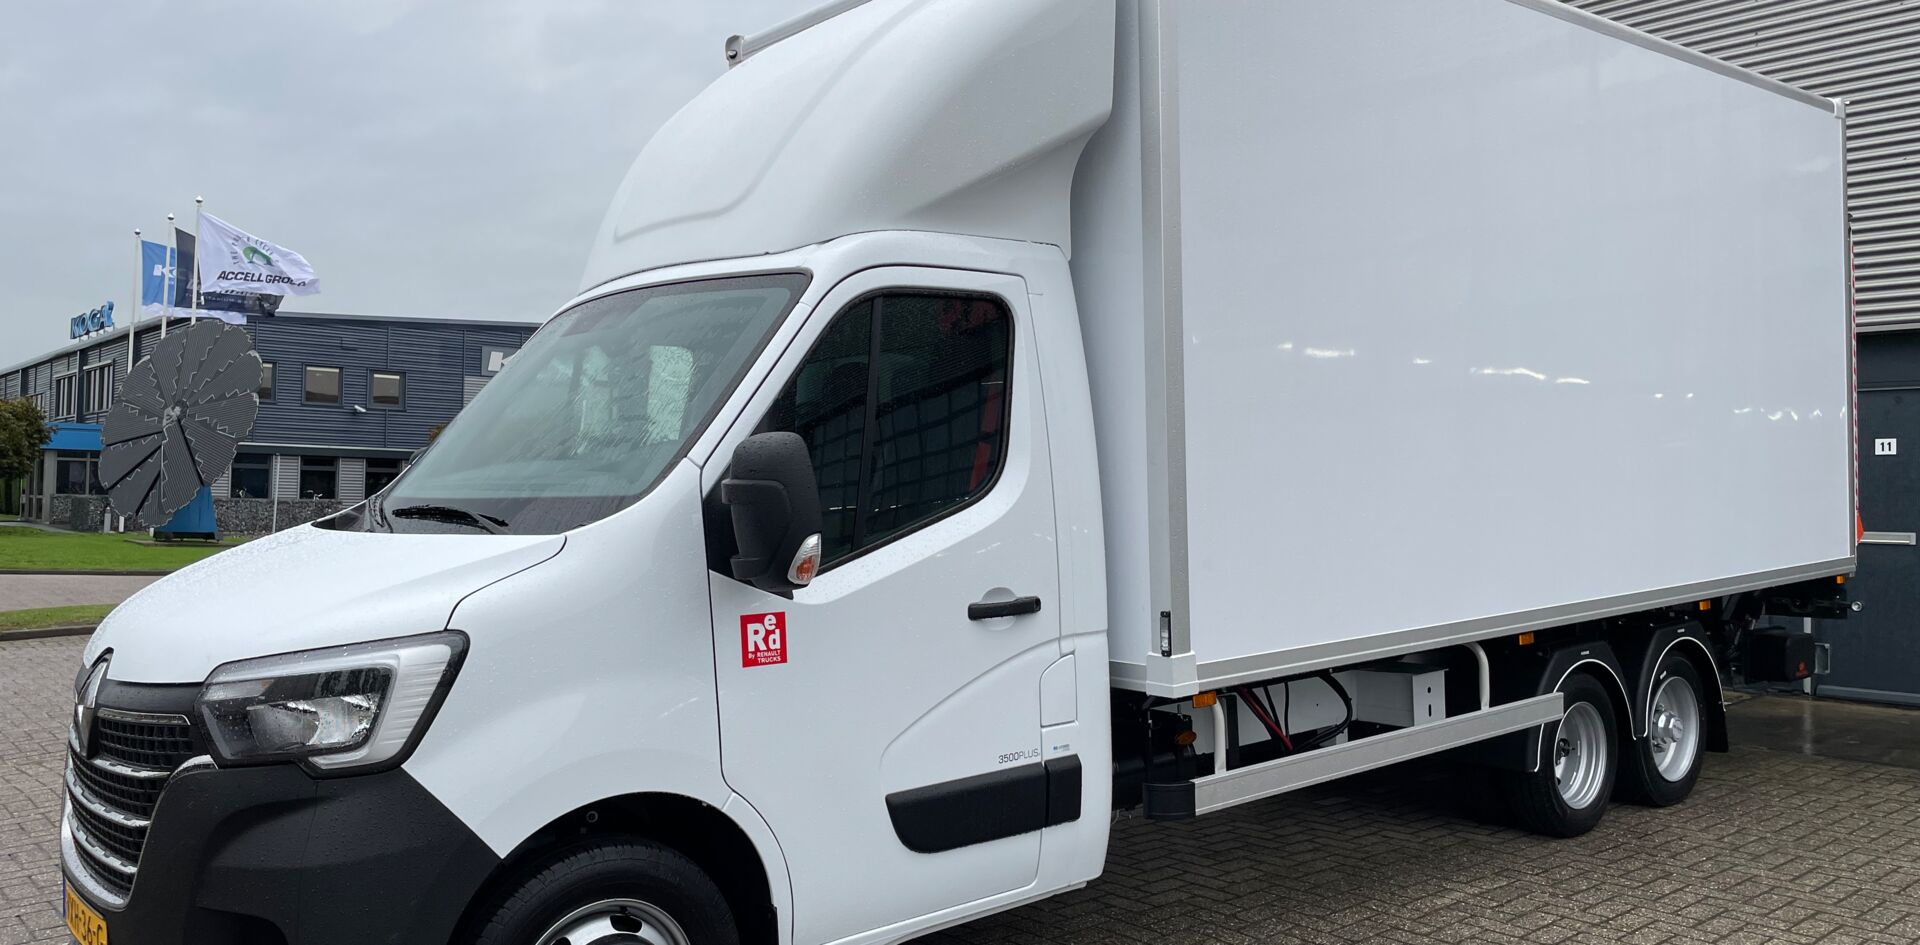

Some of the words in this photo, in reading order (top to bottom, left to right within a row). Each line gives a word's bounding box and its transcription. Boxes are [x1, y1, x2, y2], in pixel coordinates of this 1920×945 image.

[217, 270, 264, 283] ACCELL
[70, 301, 113, 339] KOGA
[1880, 441, 1892, 452] 11
